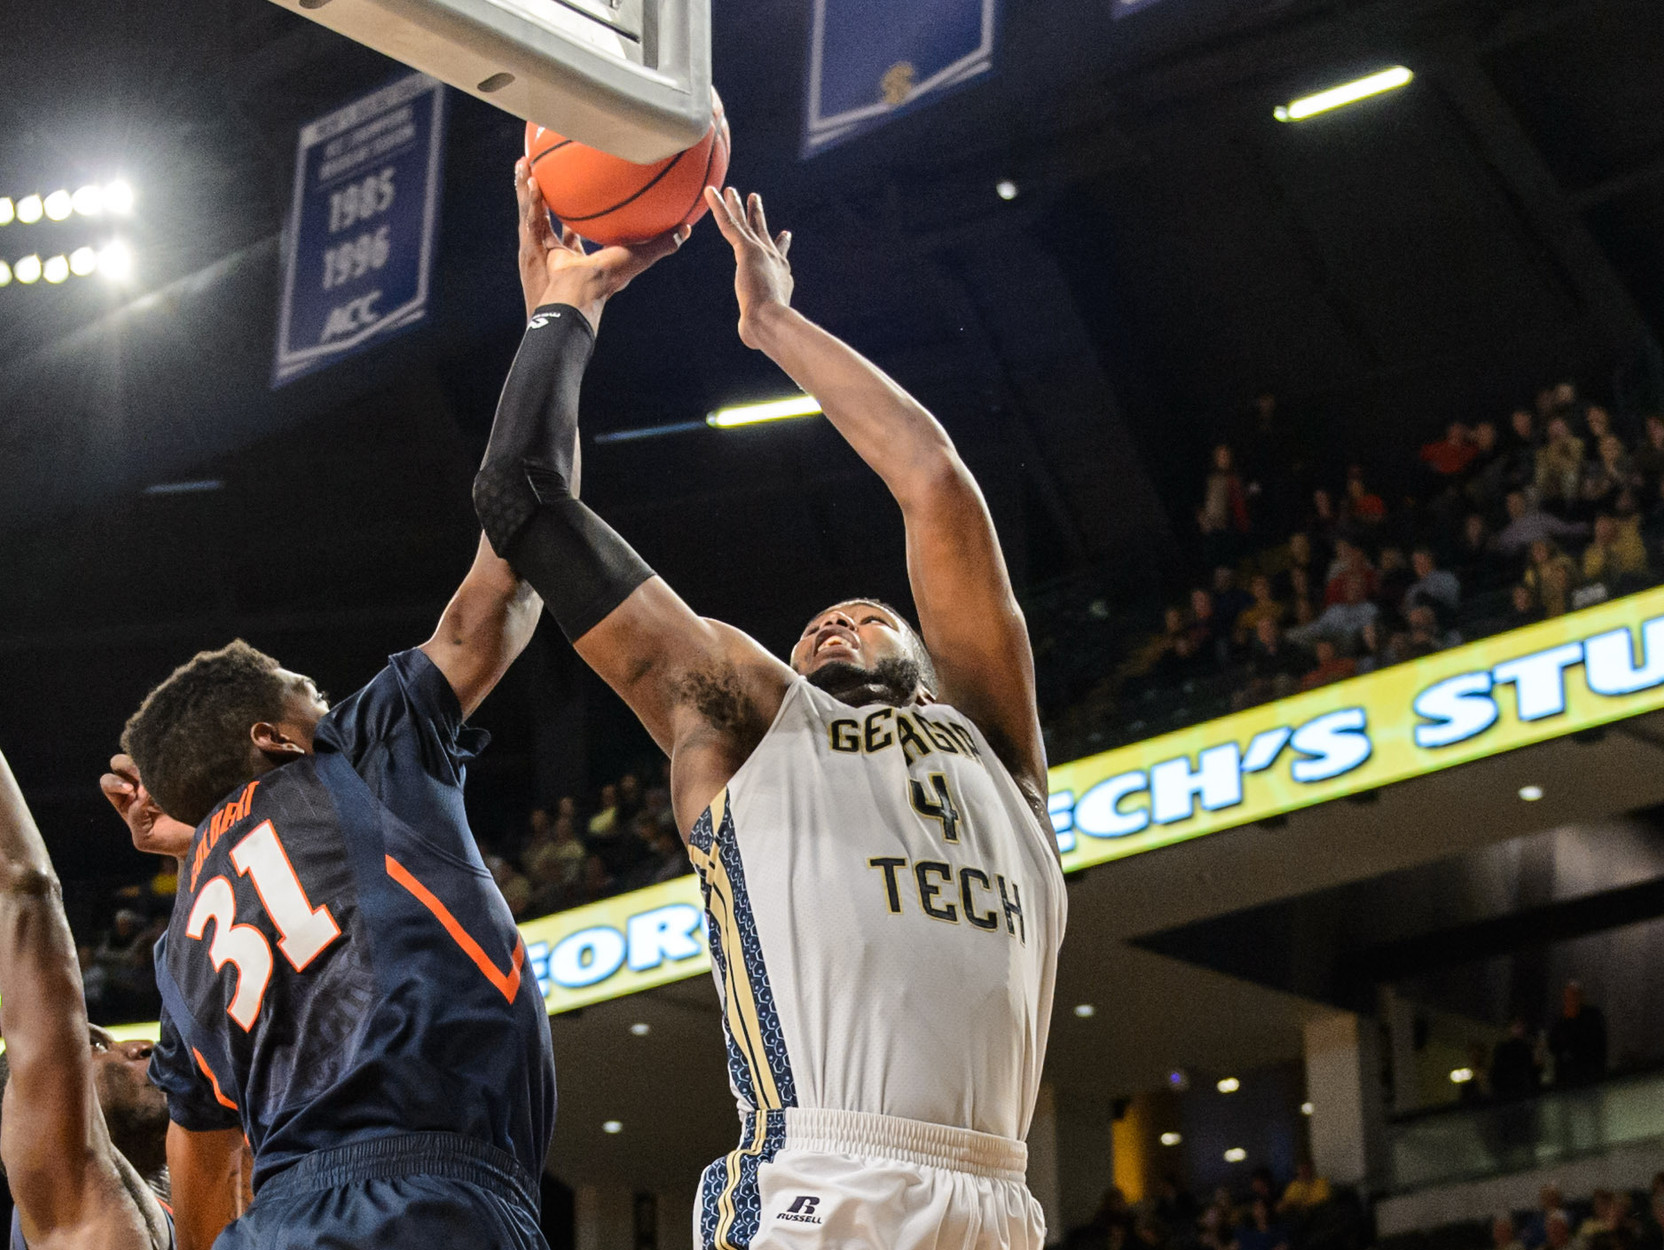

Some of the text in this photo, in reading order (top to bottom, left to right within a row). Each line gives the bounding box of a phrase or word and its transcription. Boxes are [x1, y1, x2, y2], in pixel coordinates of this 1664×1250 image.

[322, 224, 389, 291] 1996
[320, 289, 382, 345] ACC
[907, 771, 960, 844] 4
[186, 818, 341, 1033] 31
[867, 857, 1026, 948] TECH
[776, 1212, 822, 1224] RUSSELL
